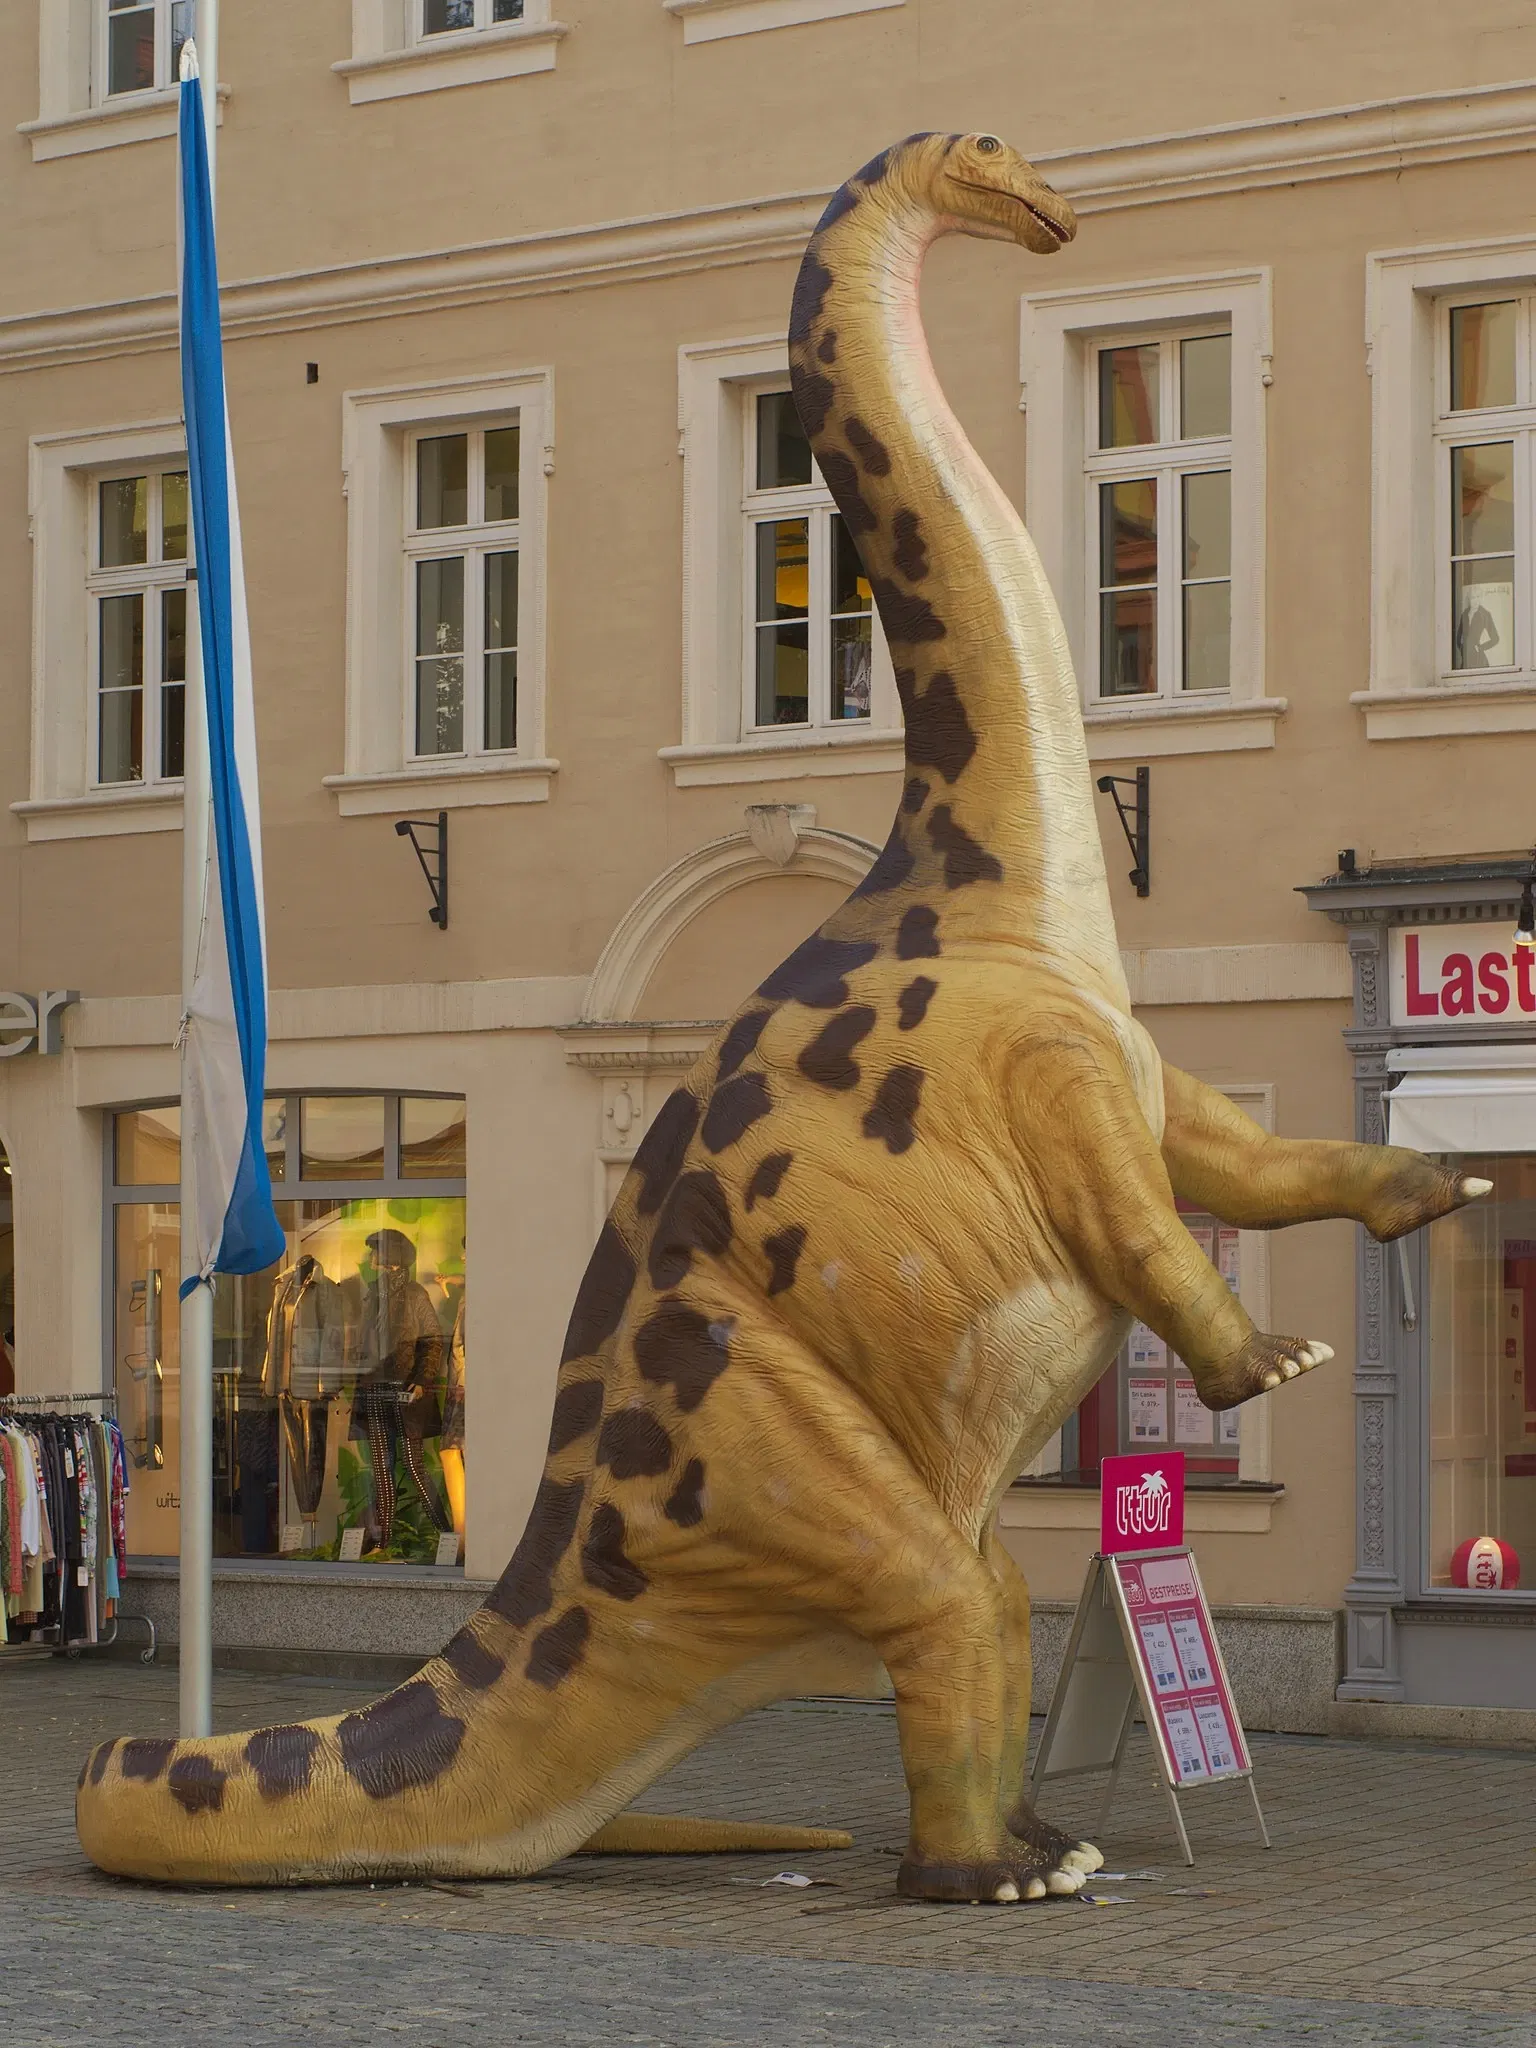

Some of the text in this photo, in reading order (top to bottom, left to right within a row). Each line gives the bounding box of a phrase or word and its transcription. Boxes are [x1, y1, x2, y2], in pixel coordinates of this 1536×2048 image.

[1405, 934, 1536, 1017] Last
[156, 1492, 180, 1508] wit
[1149, 1583, 1194, 1599] BESTPREISE!
